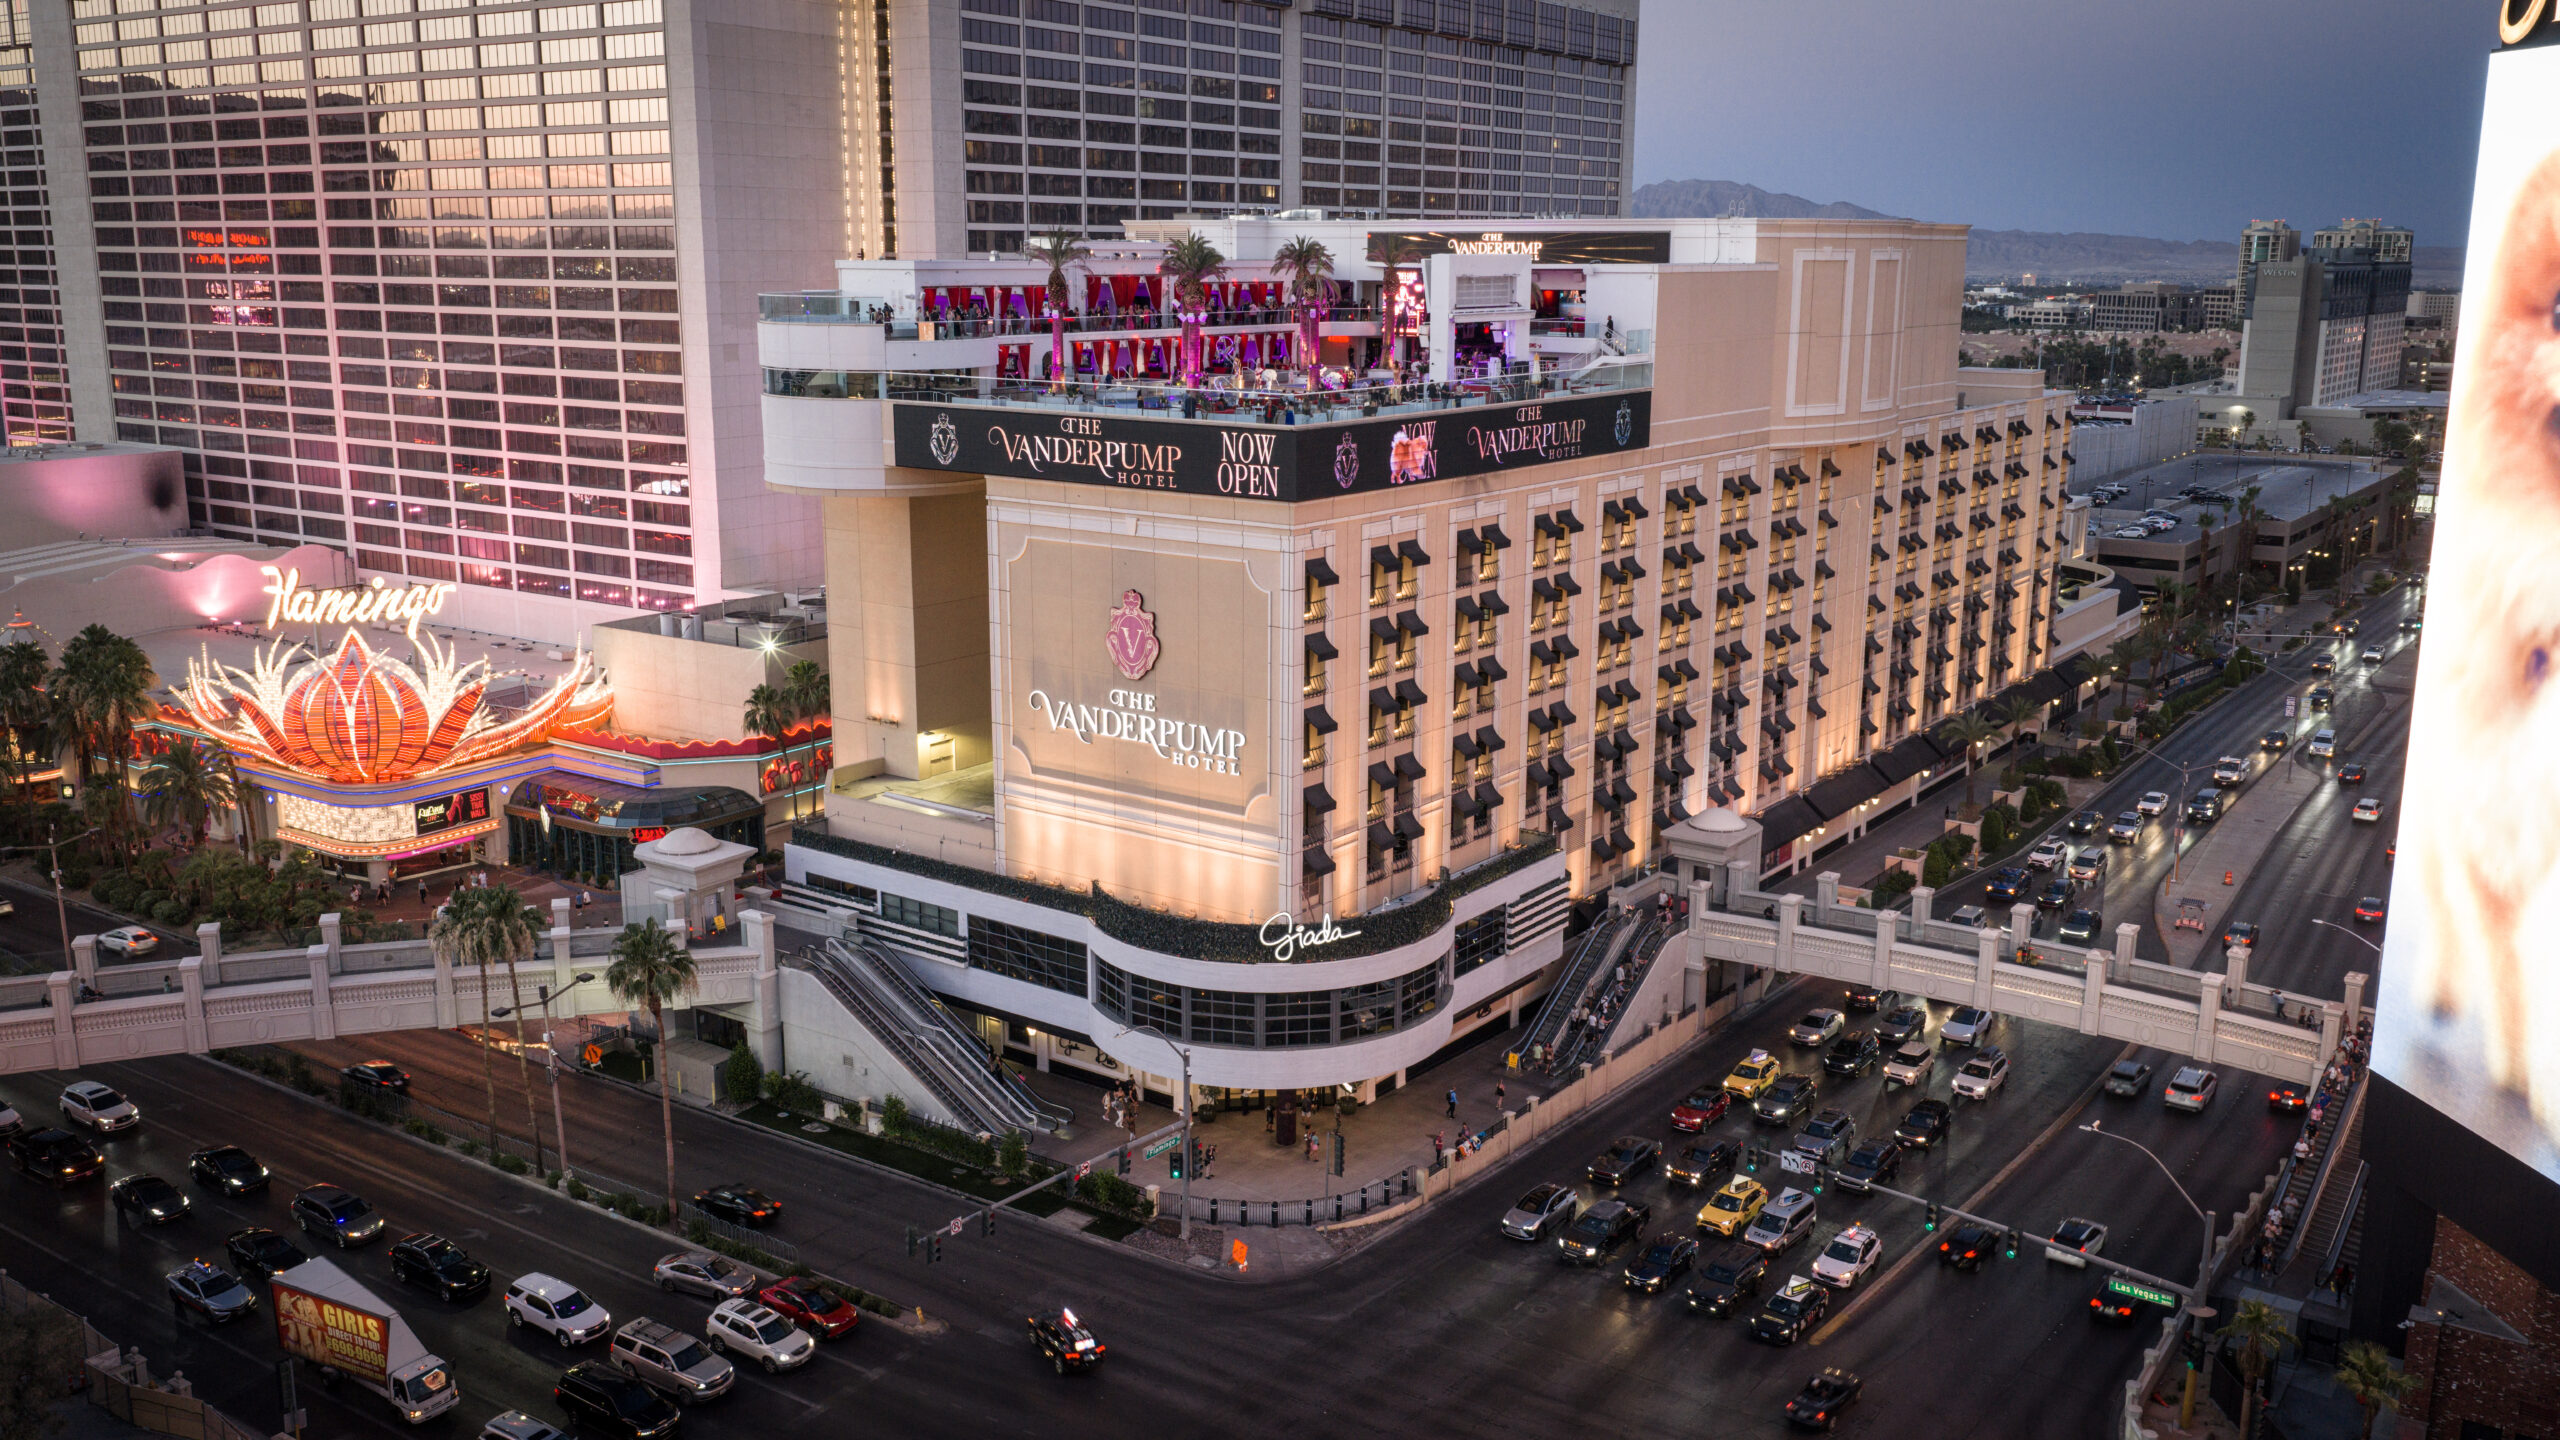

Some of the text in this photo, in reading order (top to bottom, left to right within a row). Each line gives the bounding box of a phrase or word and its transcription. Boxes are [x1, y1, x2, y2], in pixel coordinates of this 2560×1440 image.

[1448, 238, 1543, 255] VANDERPUMP
[1482, 233, 1503, 241] THE
[2263, 268, 2297, 277] WESTIN
[1516, 405, 1543, 422] THE
[1060, 417, 1102, 436] THE
[988, 425, 1182, 478] VANDERPUMP
[1221, 431, 1277, 465] NOW
[1467, 419, 1586, 464] VANDERPUMP
[1549, 445, 1583, 460] HOTEL
[1118, 471, 1177, 489] HOTEL
[1217, 462, 1279, 498] OPEN
[260, 566, 457, 639] Flamingo
[1122, 627, 1143, 658] V
[1109, 688, 1157, 712] THE
[1028, 689, 1247, 760] VANDERPUMP
[1173, 752, 1242, 777] HOTEL
[1260, 912, 1361, 961] Giada
[1150, 1139, 1176, 1157] Flamingo
[1753, 1231, 1769, 1240] TAXI
[2115, 1282, 2131, 1293] Las
[2133, 1286, 2159, 1301] Vegas
[323, 1304, 380, 1342] GIRLS
[328, 1326, 353, 1343] DIRECT
[354, 1335, 364, 1347] TO
[363, 1339, 381, 1352] YOU!
[331, 1338, 386, 1368] 696-9696
